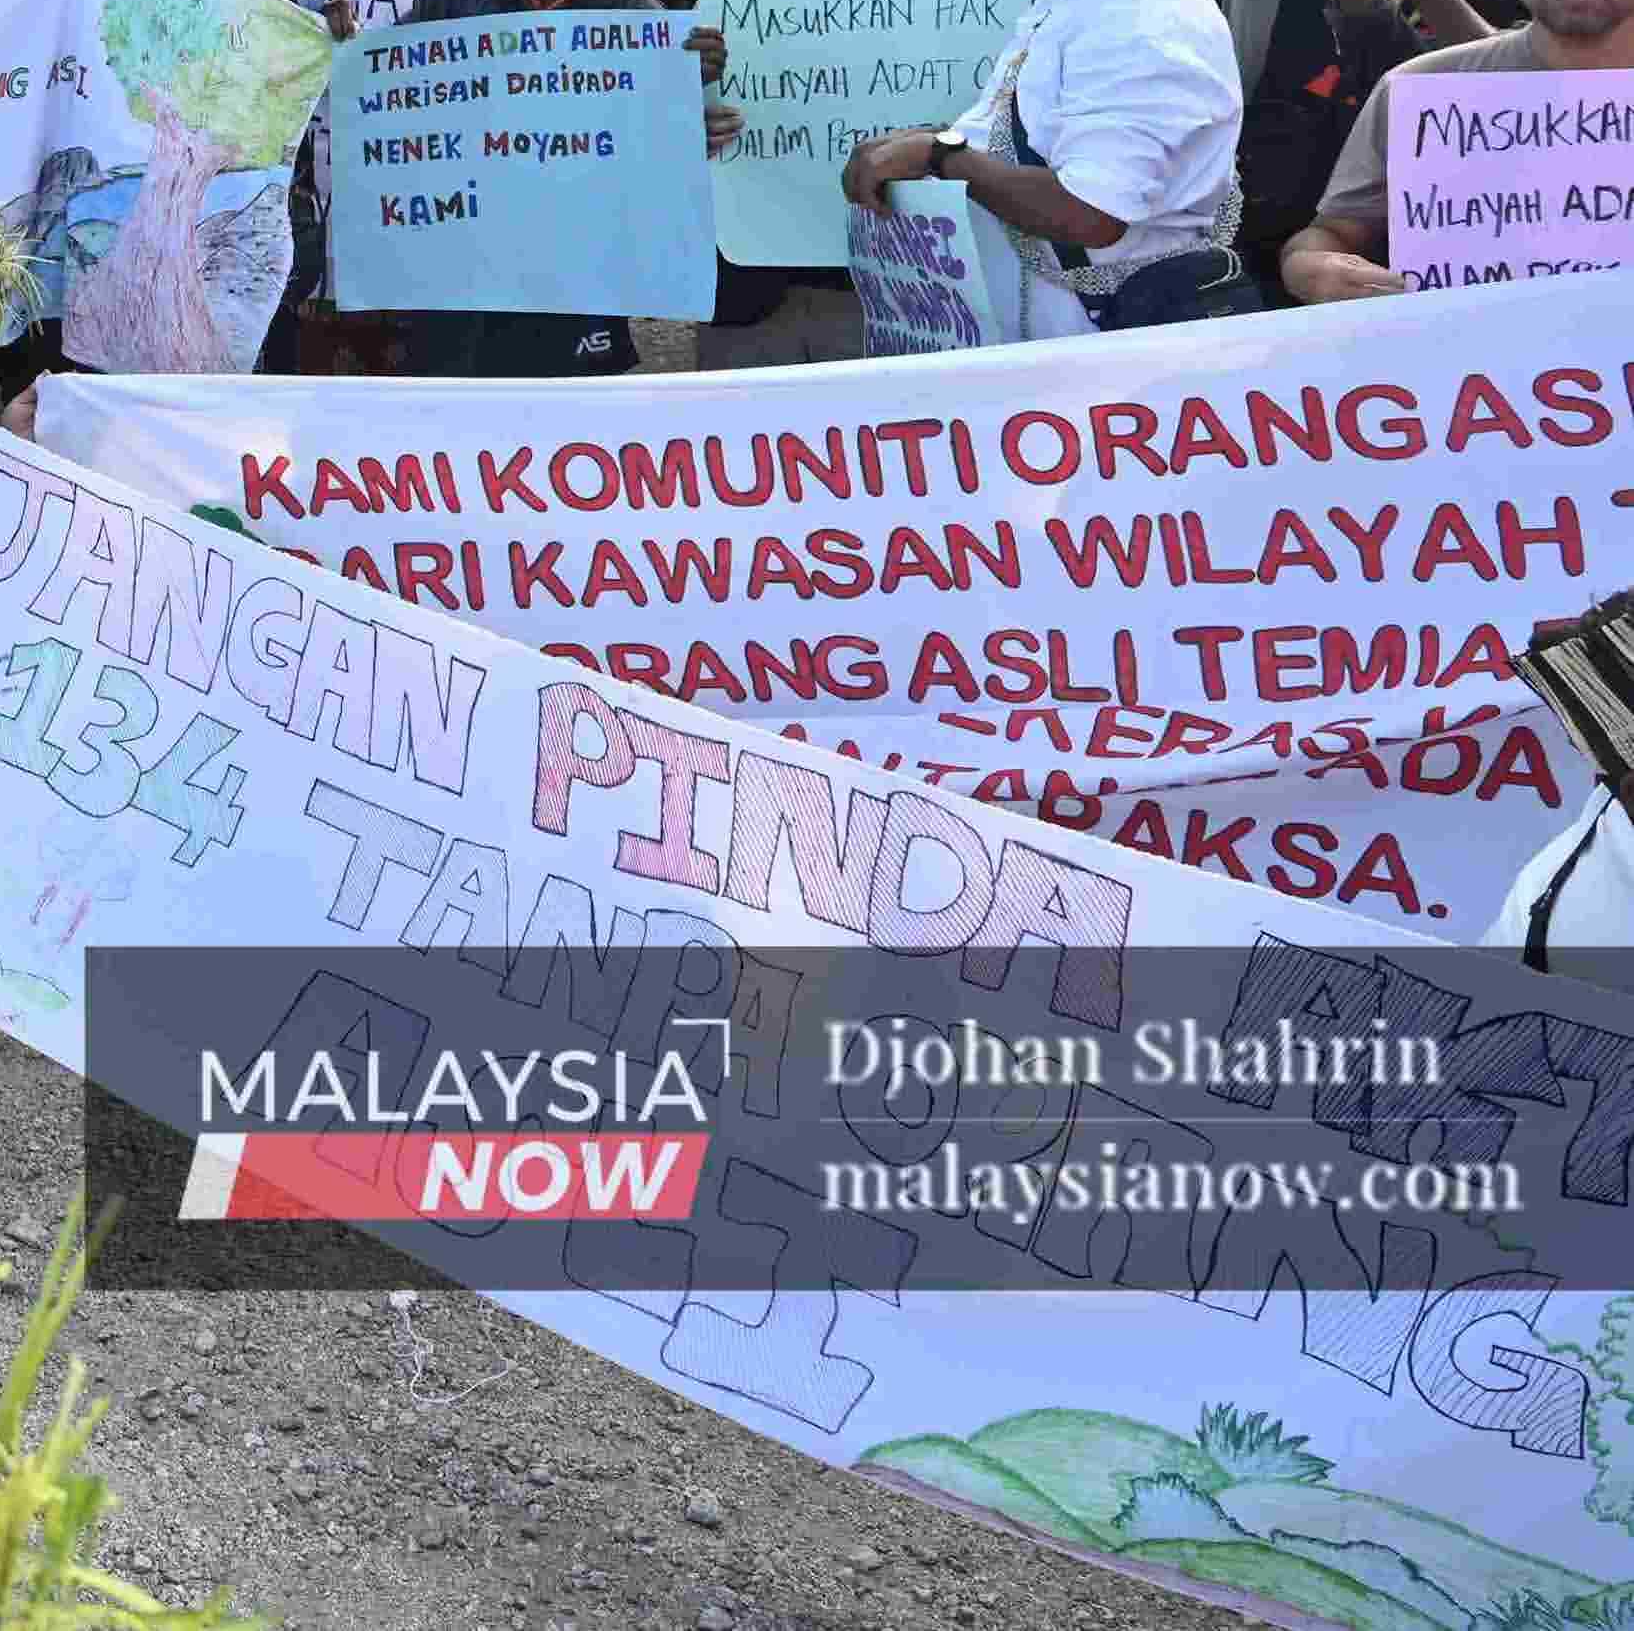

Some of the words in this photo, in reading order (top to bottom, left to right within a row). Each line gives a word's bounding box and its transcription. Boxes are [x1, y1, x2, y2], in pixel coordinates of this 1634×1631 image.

[364, 35, 469, 75] TANAH
[476, 24, 557, 59] ADAT
[570, 20, 672, 53] ADALAH
[718, 62, 849, 105] WILAYAH
[868, 58, 964, 98] ADAT
[363, 132, 463, 167] NENEK
[483, 129, 615, 164] MOYANG
[1402, 187, 1542, 241] WILAYAH
[241, 449, 463, 521] KAMI
[476, 418, 979, 511] KOMUNITI
[1000, 383, 1429, 486] ORANG
[511, 519, 1022, 611] KAWASAN
[1043, 495, 1585, 589] WILAYAH
[908, 627, 1141, 708] ASLI
[531, 679, 1133, 1031] PINDA
[304, 777, 806, 1121] TANPA
